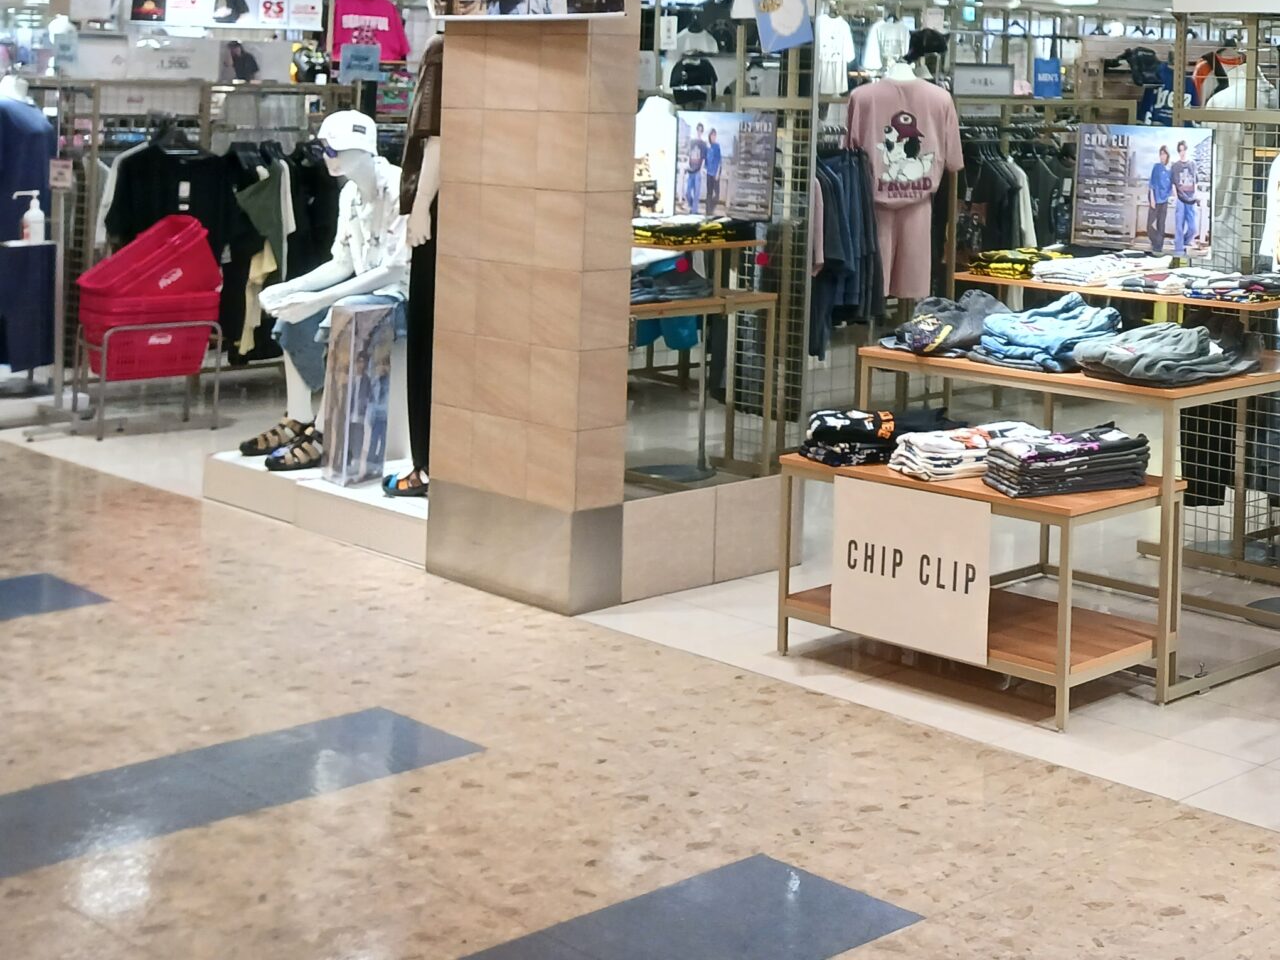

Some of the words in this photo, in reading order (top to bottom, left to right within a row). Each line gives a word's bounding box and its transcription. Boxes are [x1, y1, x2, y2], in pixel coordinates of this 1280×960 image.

[877, 177, 932, 192] PROUD
[847, 539, 904, 579] CHIP
[919, 553, 977, 595] CLIP
